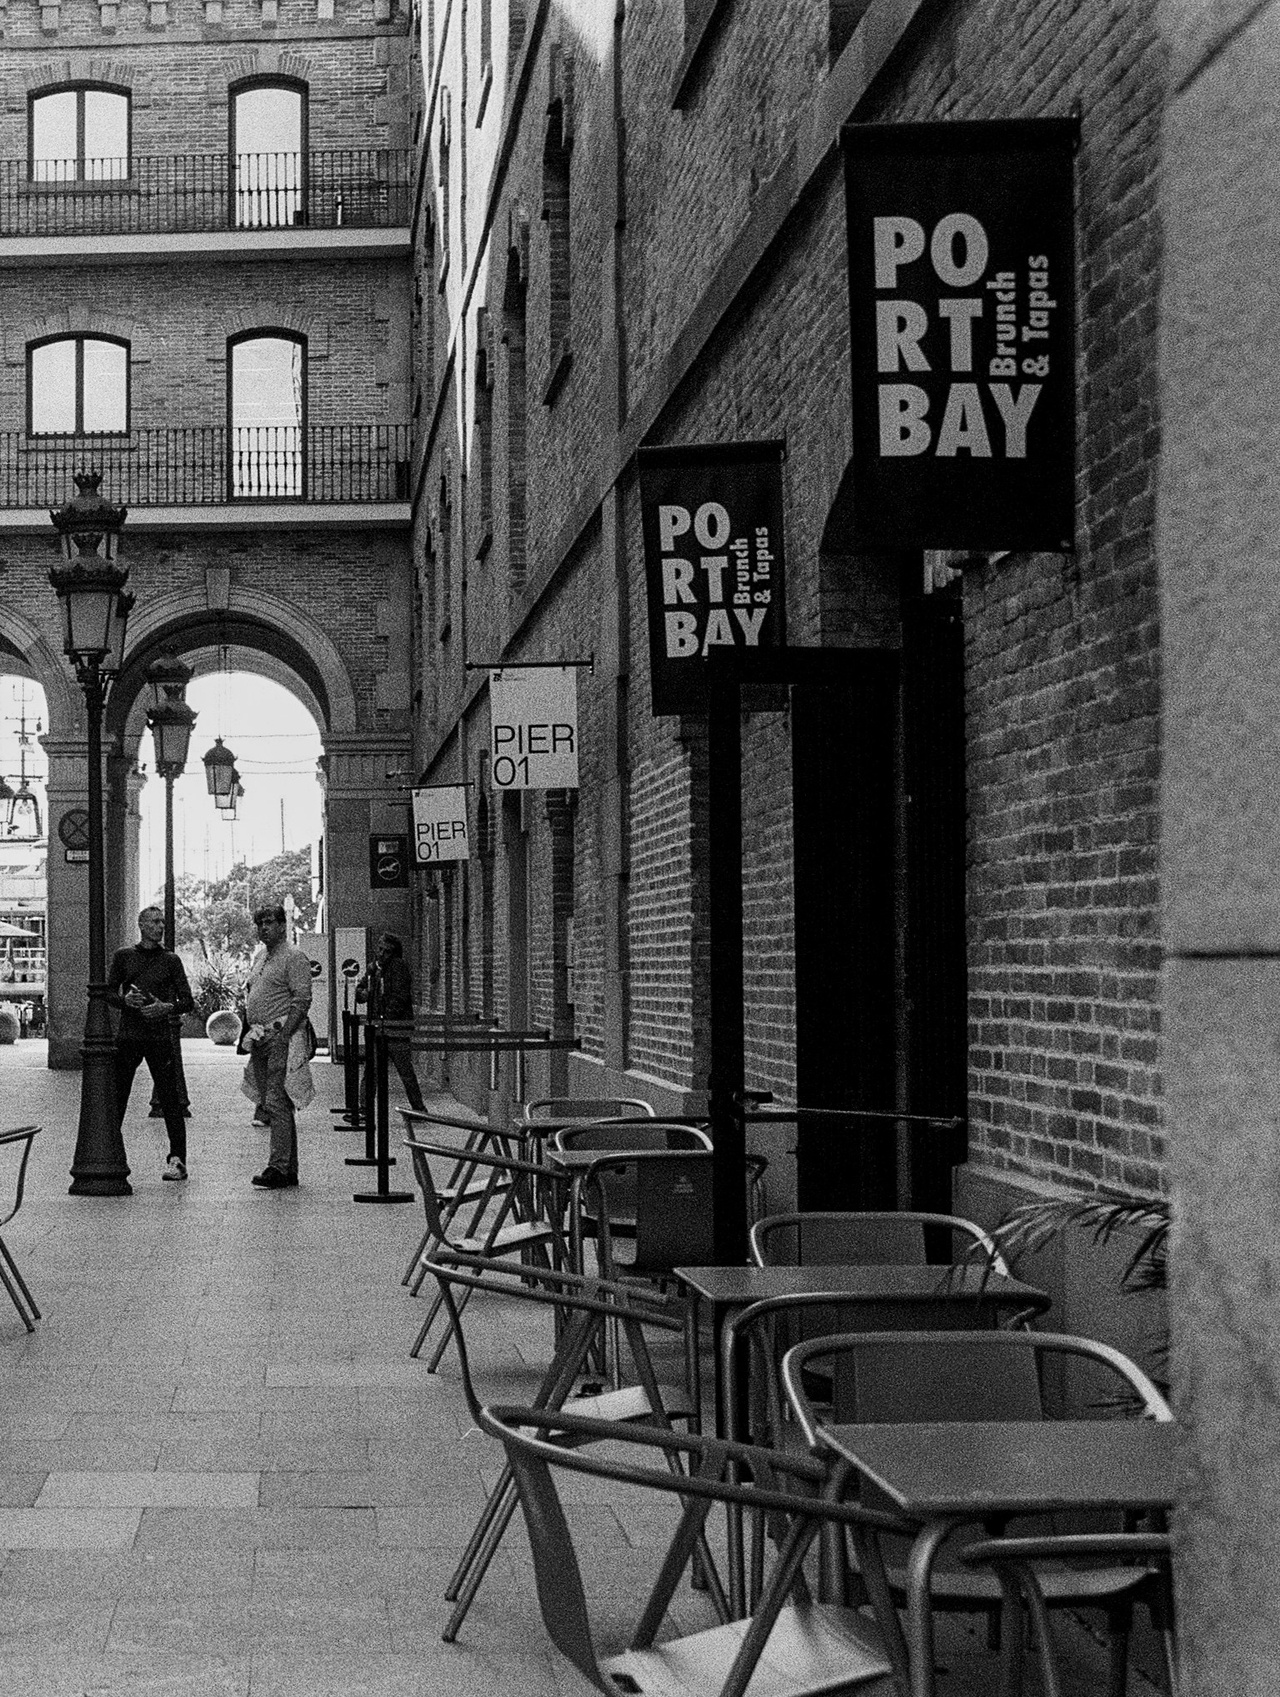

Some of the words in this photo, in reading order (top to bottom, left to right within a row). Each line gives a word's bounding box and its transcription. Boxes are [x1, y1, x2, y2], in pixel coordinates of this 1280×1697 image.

[873, 213, 989, 289] PO
[986, 271, 1017, 376] Brunch
[1021, 254, 1057, 342] Tapas
[875, 298, 983, 373] RT
[1021, 354, 1050, 377] &
[877, 382, 1043, 458] BAY
[658, 502, 731, 551] PO
[661, 555, 728, 605] RT
[729, 538, 751, 604] Brunch
[753, 527, 774, 582] Tapas
[753, 589, 771, 604] &
[664, 608, 768, 658] BAY
[494, 724, 574, 754] PIER
[416, 821, 466, 841] PIER
